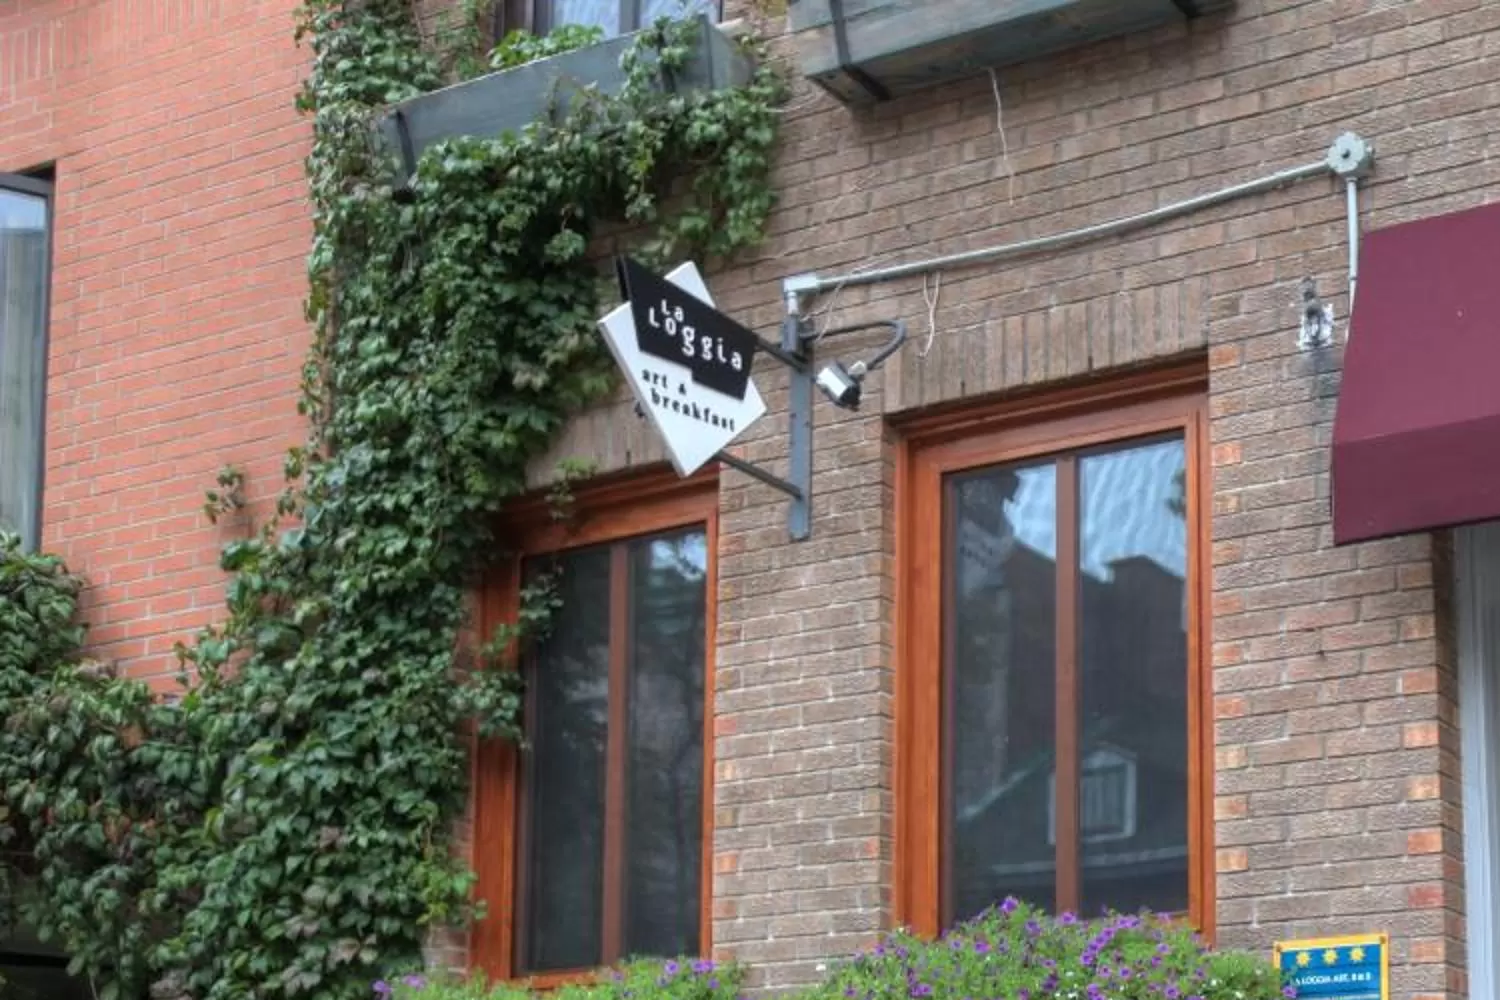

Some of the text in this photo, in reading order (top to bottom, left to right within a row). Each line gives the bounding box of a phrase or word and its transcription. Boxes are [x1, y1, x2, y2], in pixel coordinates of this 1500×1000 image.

[648, 306, 743, 372] Loggia
[641, 368, 668, 389] art
[650, 387, 736, 432] breakfast
